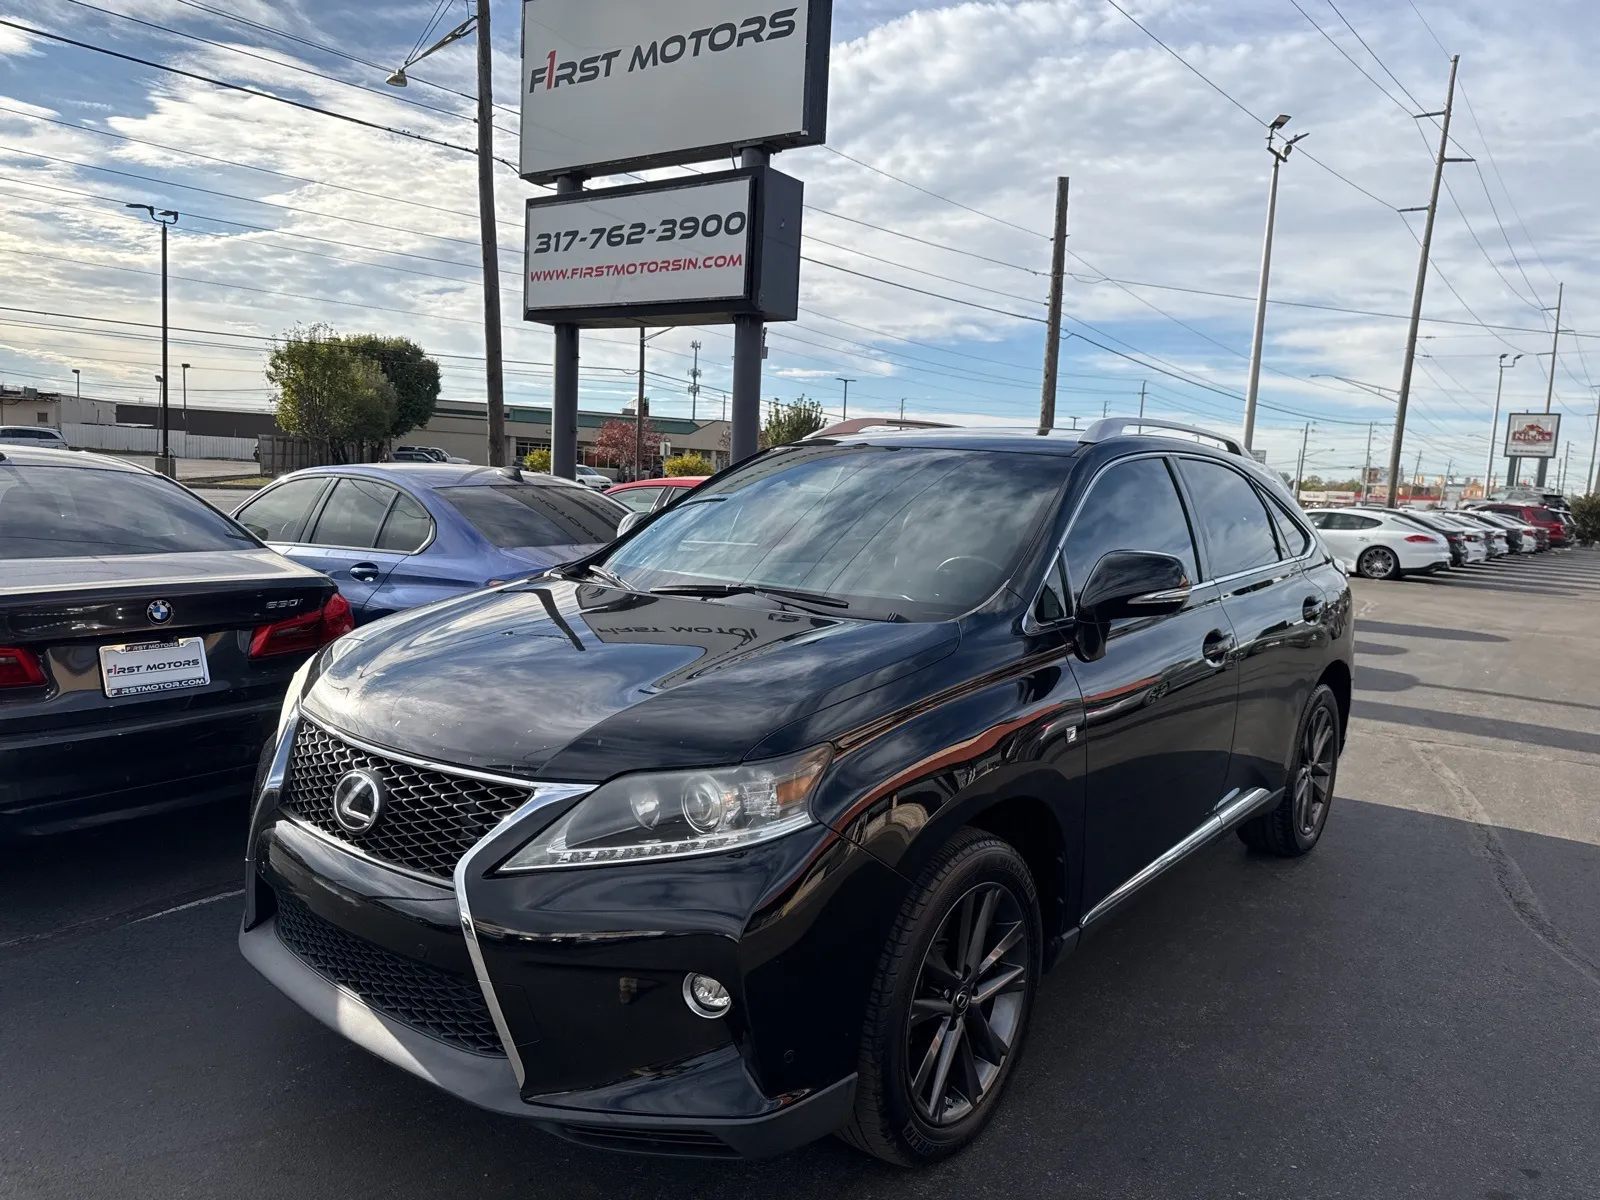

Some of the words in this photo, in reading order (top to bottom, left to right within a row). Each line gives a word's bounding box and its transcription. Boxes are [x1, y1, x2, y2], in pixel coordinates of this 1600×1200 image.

[627, 7, 798, 73] MOTORS
[533, 211, 747, 254] 317-762-3900
[530, 254, 743, 282] WWW.FIRSTMOTORSIN.COM
[146, 659, 200, 671] MOTORS
